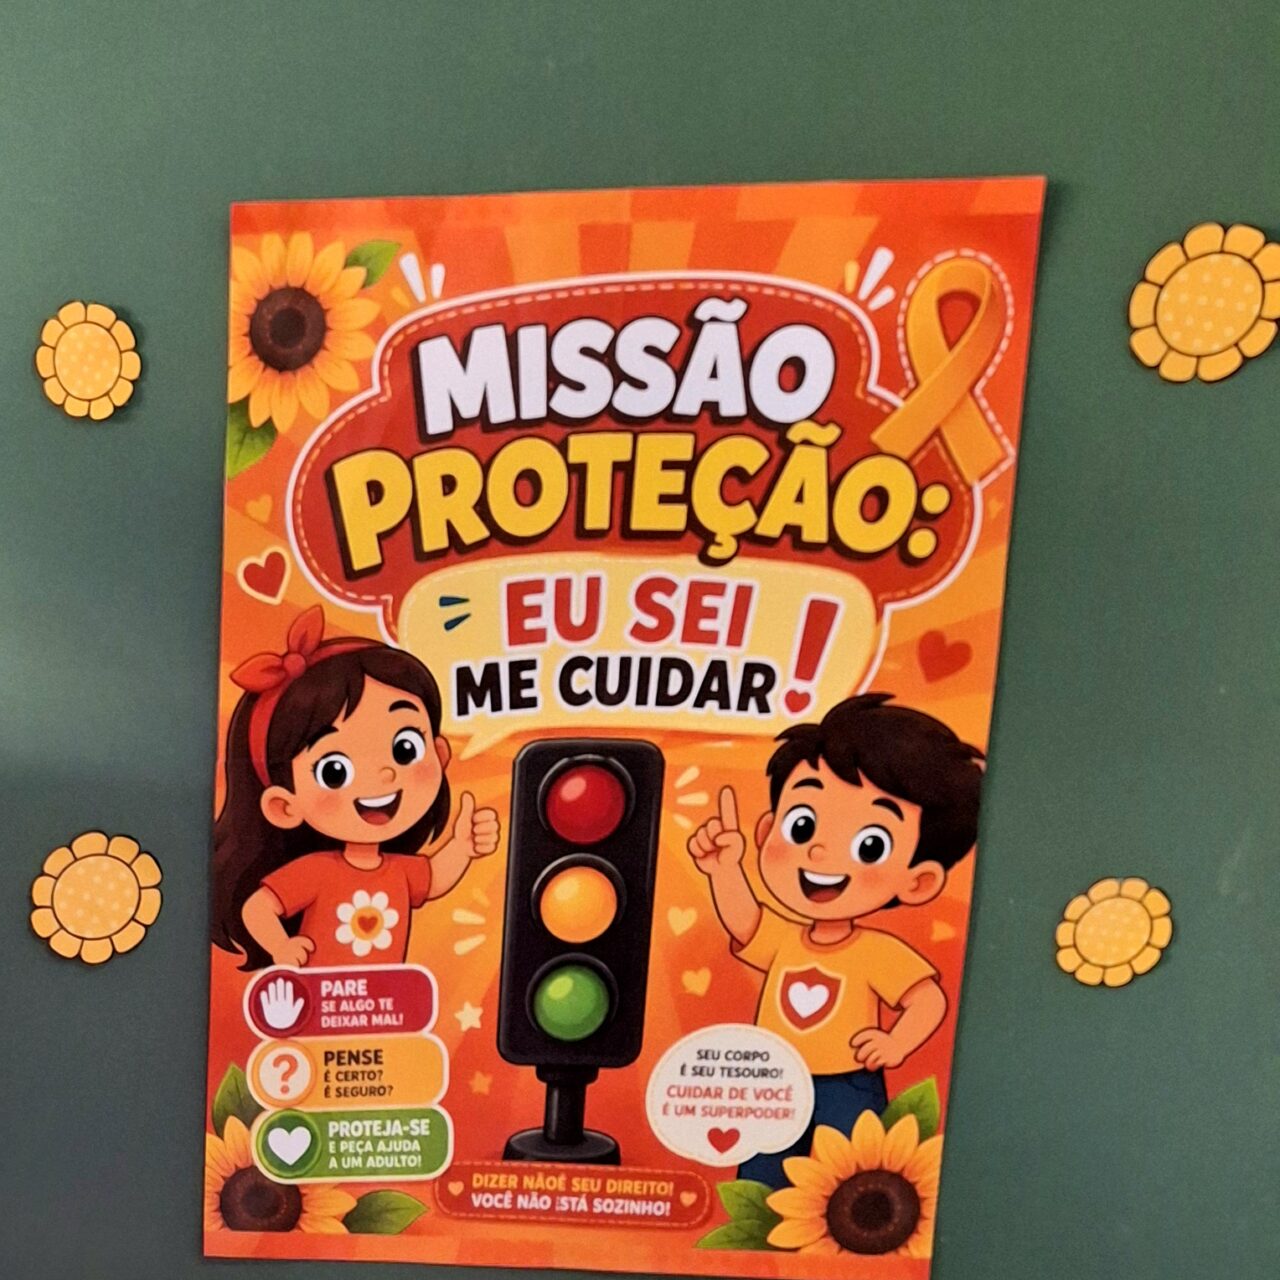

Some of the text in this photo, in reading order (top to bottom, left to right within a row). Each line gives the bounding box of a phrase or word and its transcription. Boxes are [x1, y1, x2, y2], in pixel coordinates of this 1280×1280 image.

[416, 298, 836, 436] MISSÃO
[331, 421, 952, 572] PROTEÇÃO:
[505, 574, 756, 649] EU SEI
[455, 660, 538, 716] ME
[320, 979, 368, 997] PARE
[321, 998, 394, 1013] SE ALGO TE
[321, 1013, 404, 1028] DEIXAR MAL!
[324, 1049, 384, 1066] PENSE
[696, 1049, 770, 1061] SEU CORPO
[324, 1069, 383, 1082] É CERTO?
[680, 1063, 784, 1079] É SEU TESOURO!
[324, 1085, 393, 1098] É SEGURO?
[666, 1084, 723, 1099] CUIDAR
[729, 1087, 747, 1100] DE
[662, 1102, 796, 1119] É UM SUPERPODER!
[328, 1119, 430, 1137] PROTEJA-SE
[329, 1140, 421, 1155] E PEÇA AJUDA
[329, 1155, 421, 1169] A UM ADULTO!
[472, 1173, 518, 1189] DIZER
[571, 1177, 601, 1193] SEU
[606, 1179, 674, 1196] DIREITO!
[471, 1190, 513, 1209] VOCÊ
[517, 1192, 551, 1210] NÃO
[592, 1198, 671, 1216] SOZINHO!
